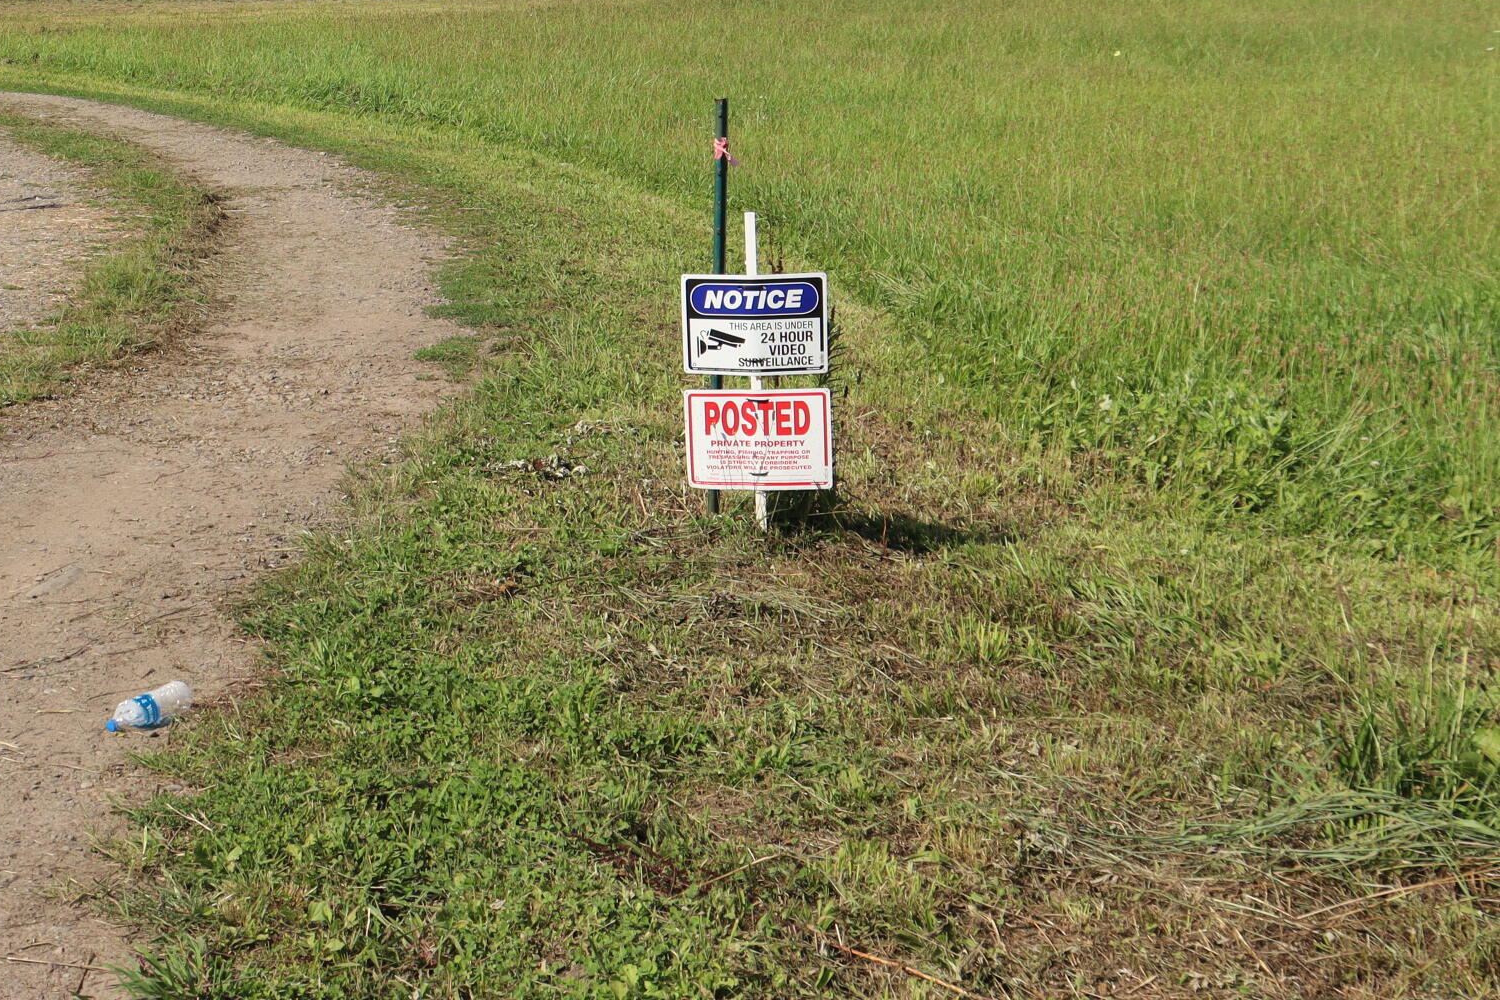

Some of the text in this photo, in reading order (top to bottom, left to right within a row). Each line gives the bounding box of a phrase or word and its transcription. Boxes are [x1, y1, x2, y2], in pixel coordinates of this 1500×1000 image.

[703, 289, 804, 310] NOTICE
[729, 320, 813, 331] THIS AREA IS UNDER
[760, 330, 813, 344] 24 HOUR
[769, 344, 806, 356] VIDEO
[738, 355, 814, 367] SURVEILLANCE
[704, 400, 811, 437] POSTED
[710, 439, 805, 448] PRIVATE PROPERTY
